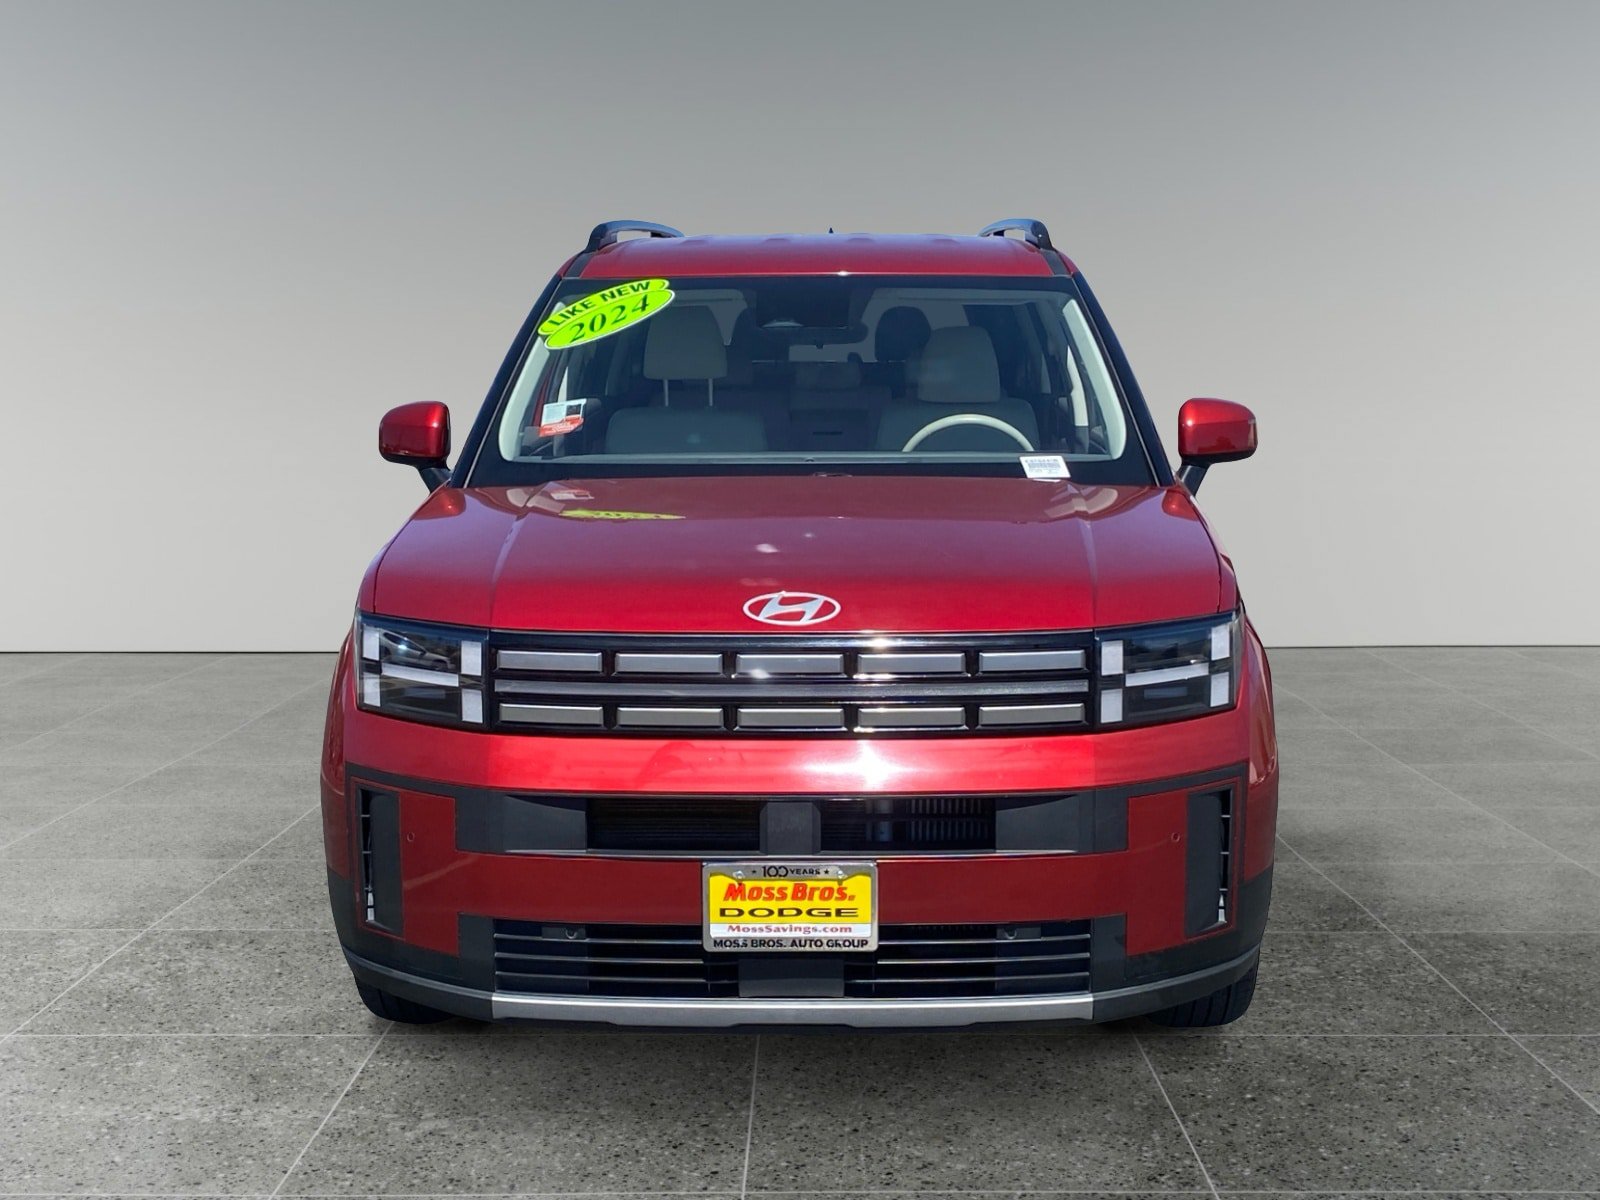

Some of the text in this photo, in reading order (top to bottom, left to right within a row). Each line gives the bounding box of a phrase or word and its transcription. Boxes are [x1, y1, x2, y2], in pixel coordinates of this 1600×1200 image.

[548, 281, 651, 327] LIKE NEW
[569, 294, 649, 343] 2024
[762, 866, 821, 878] 100 YEARS
[723, 882, 856, 901] Moss Bros.
[719, 907, 859, 918] DODGE
[727, 924, 853, 935] MossSavings.com
[713, 938, 869, 948] MOSS BROS. AUTO GROUP
